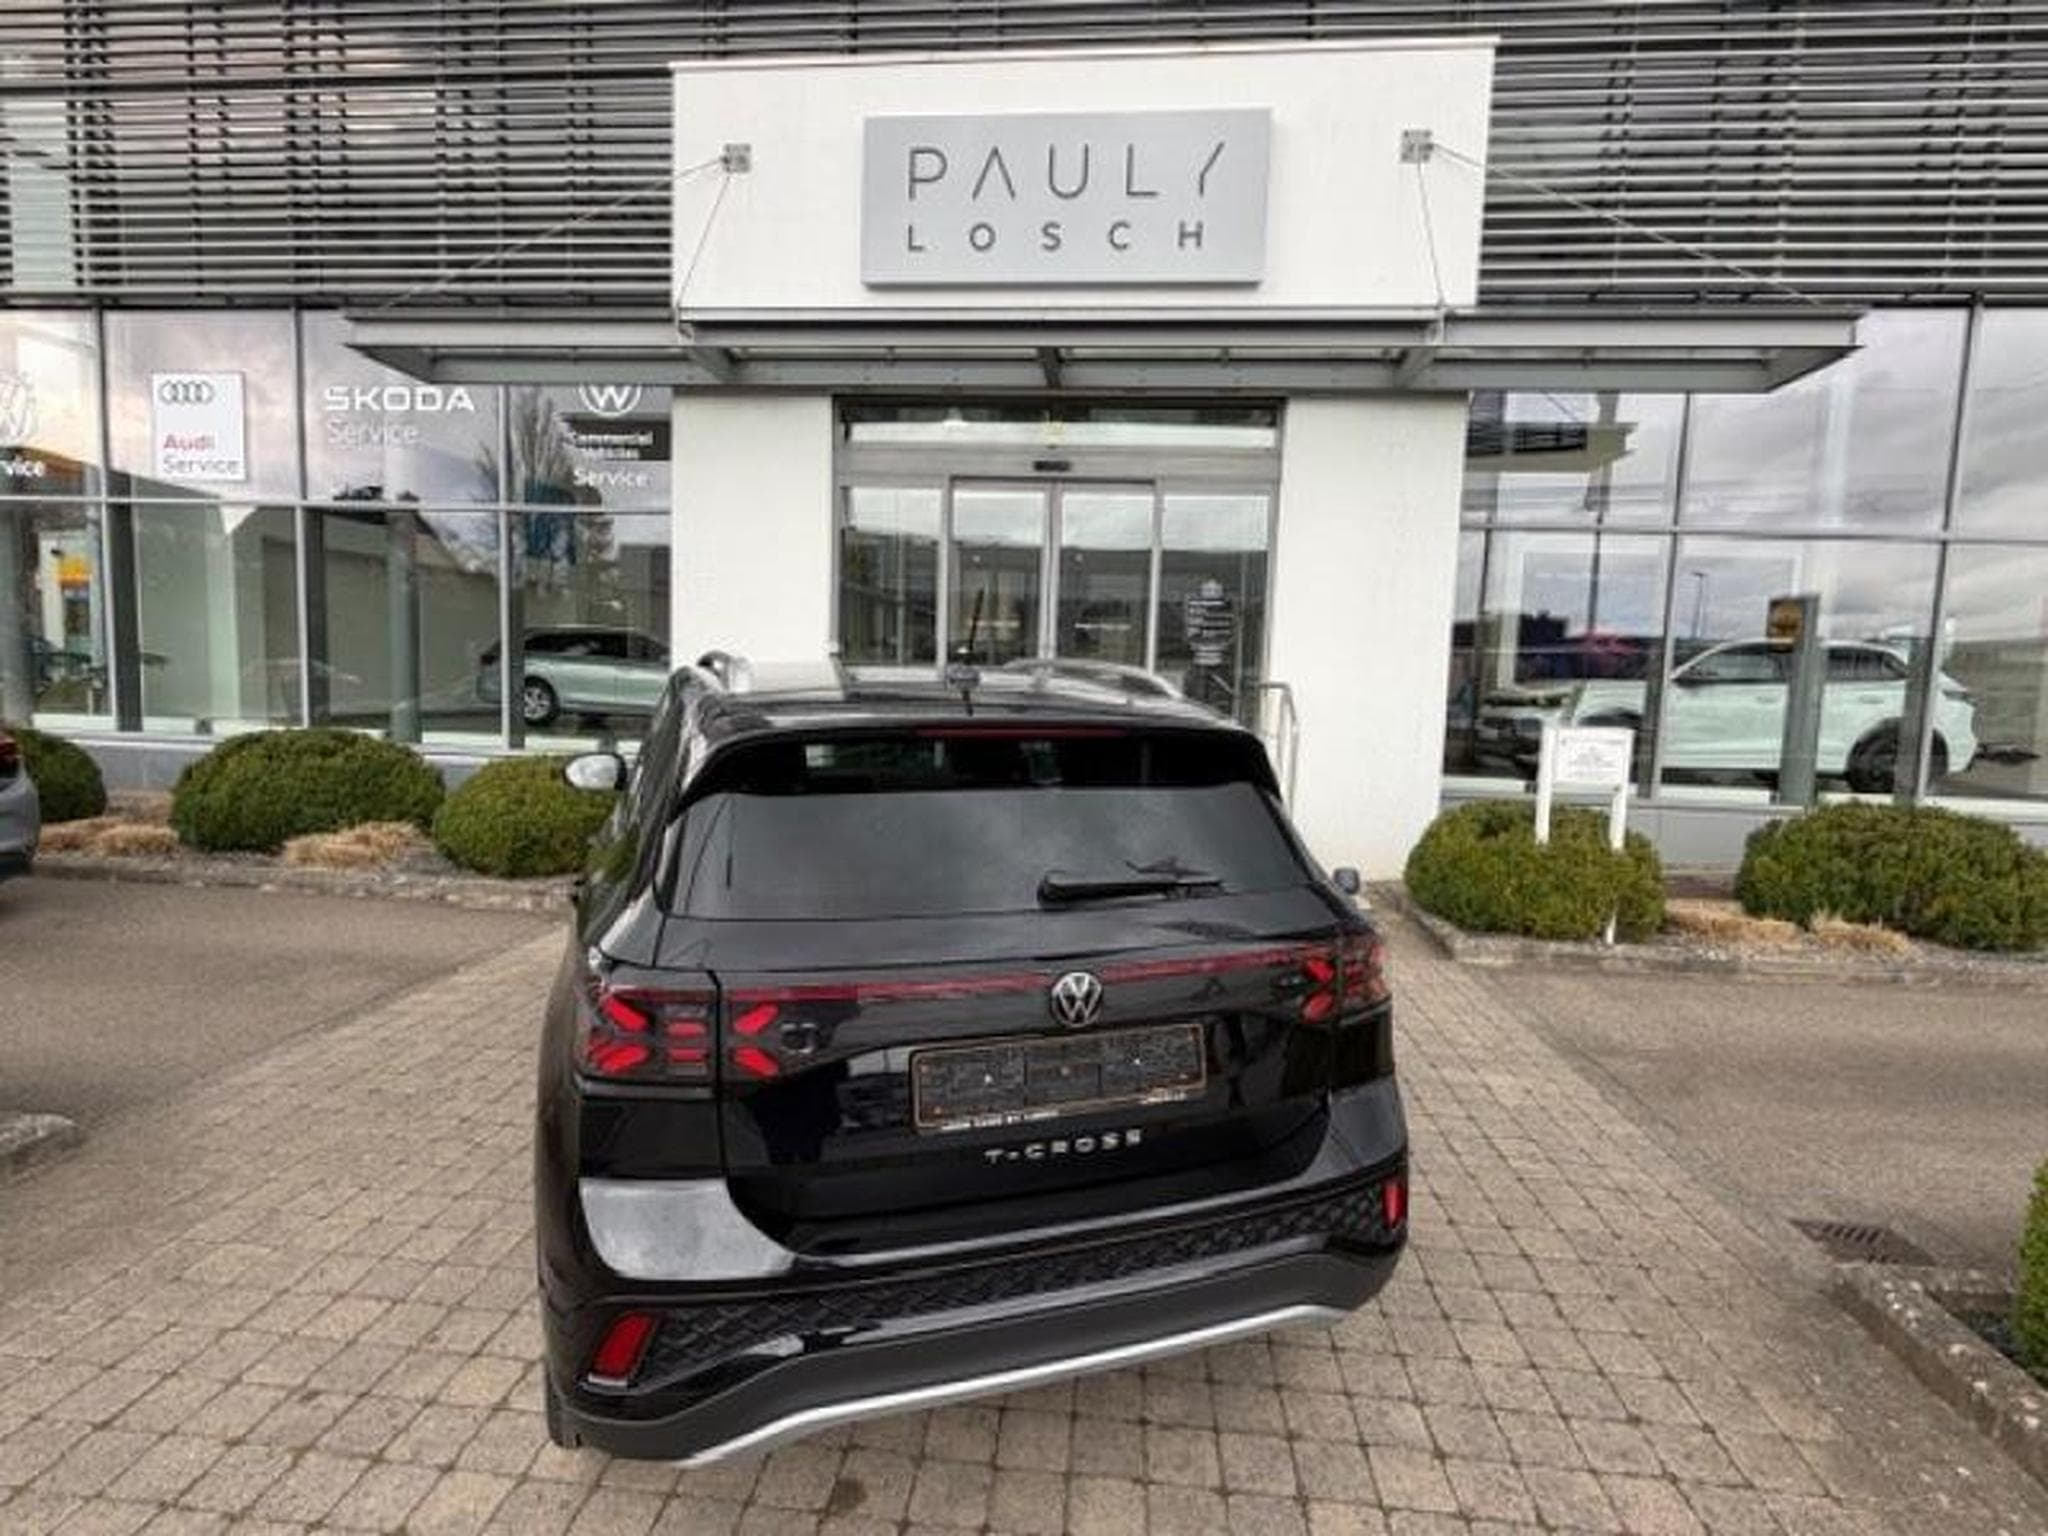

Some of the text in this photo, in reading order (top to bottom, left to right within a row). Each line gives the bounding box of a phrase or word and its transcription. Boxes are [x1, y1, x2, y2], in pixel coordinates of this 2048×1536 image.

[908, 142, 1226, 201] PAULY
[907, 220, 1206, 252] LOSCH
[162, 433, 216, 452] Audi
[326, 417, 420, 448] Service
[163, 454, 241, 475] Service
[572, 467, 652, 488] Service
[983, 1128, 1143, 1165] T-CROSS
